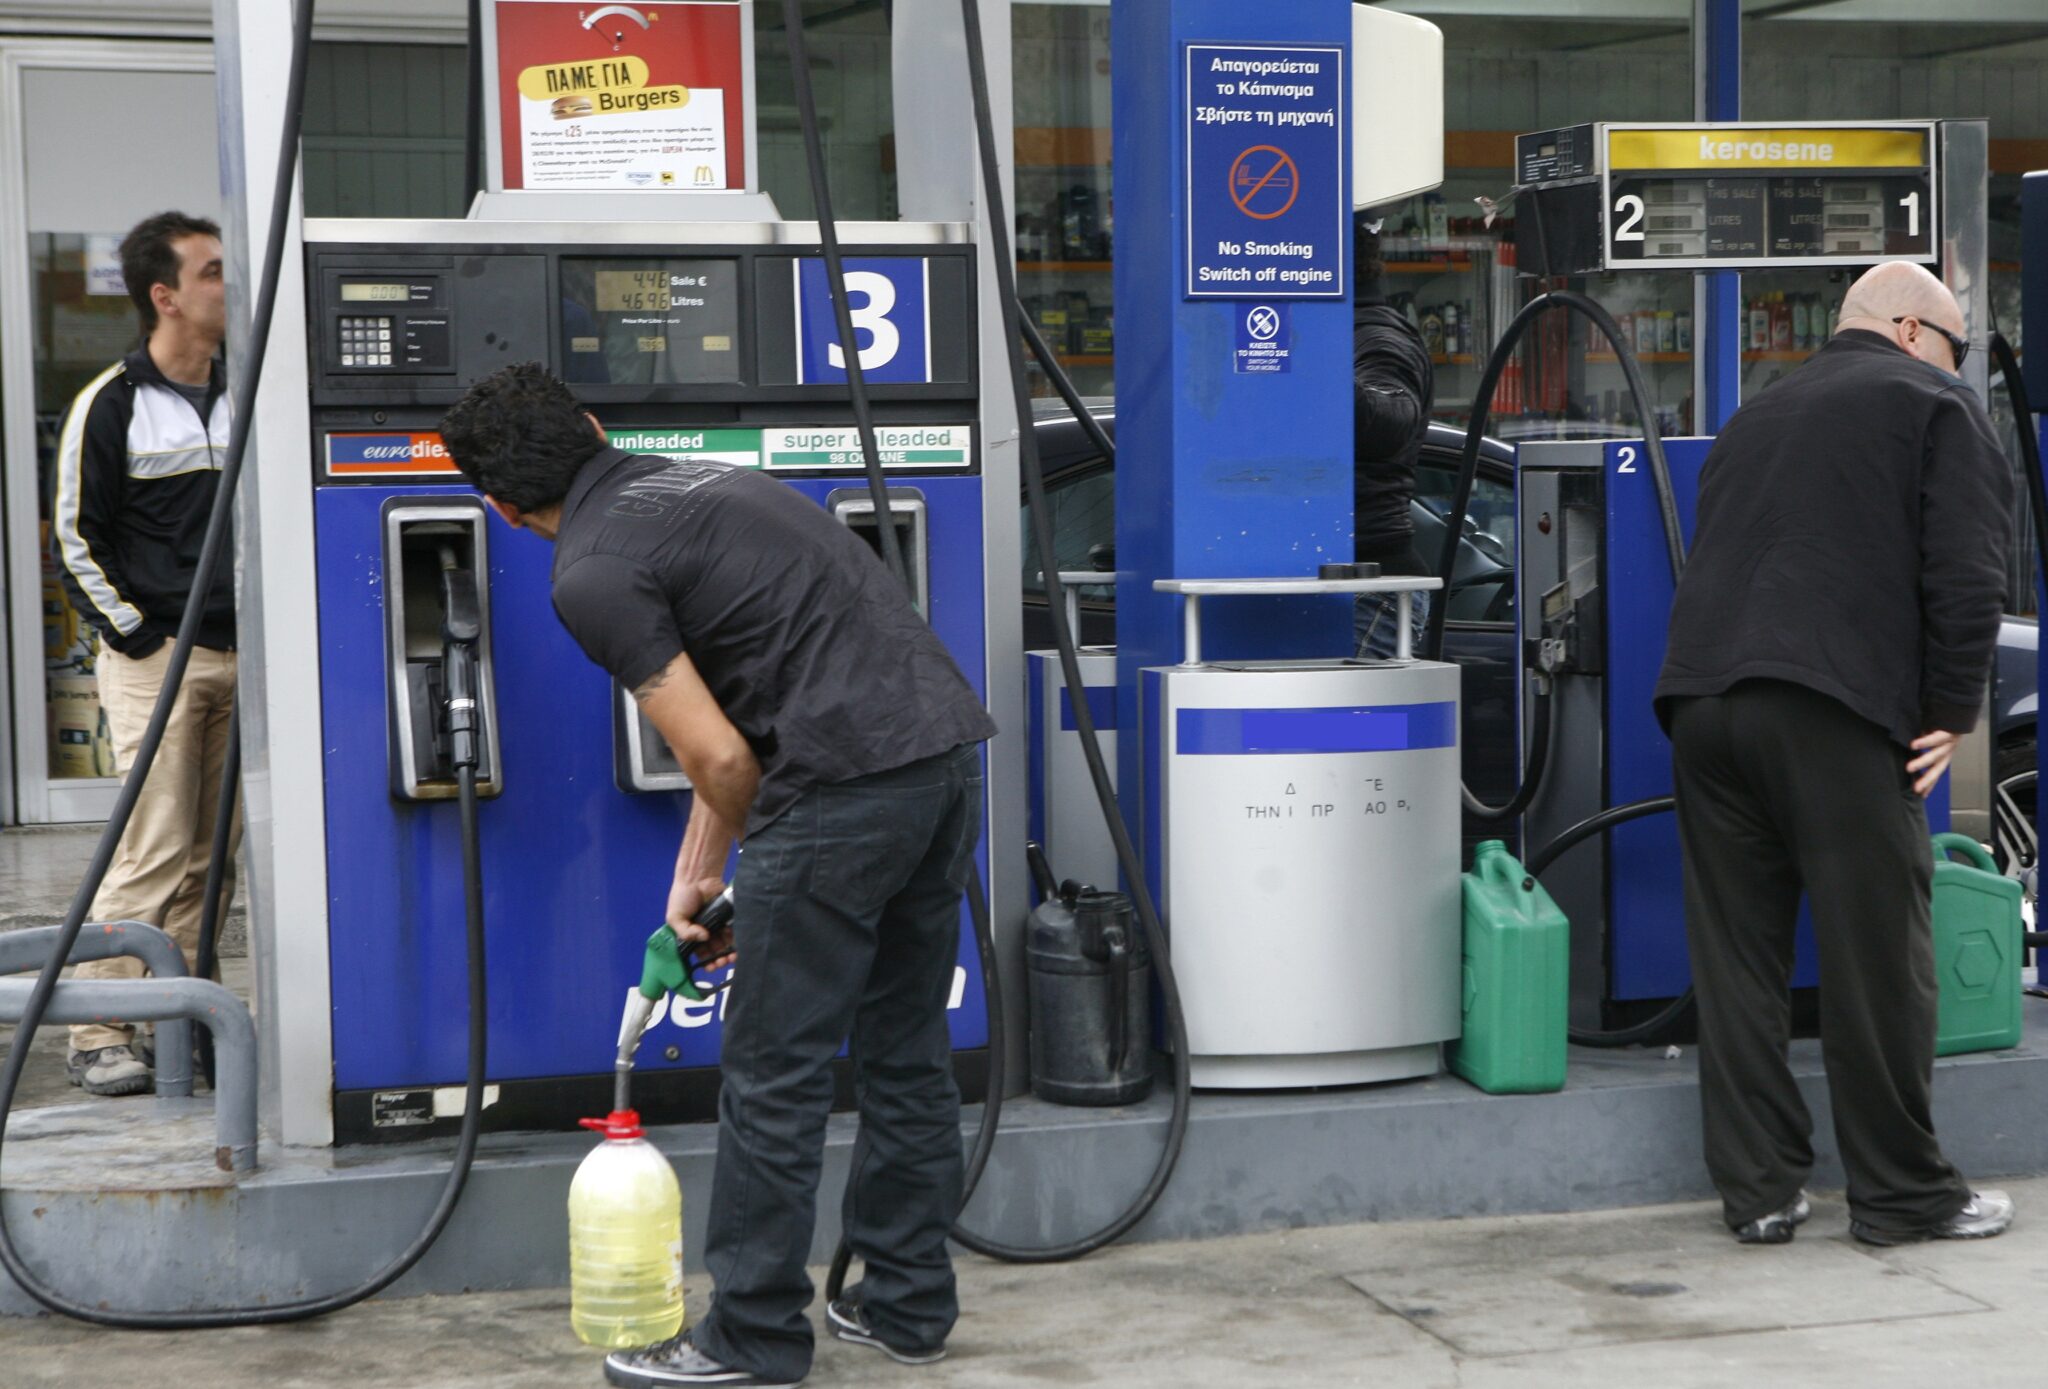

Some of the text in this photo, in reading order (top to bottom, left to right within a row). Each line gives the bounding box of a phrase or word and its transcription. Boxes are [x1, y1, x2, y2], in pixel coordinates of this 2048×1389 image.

[1211, 57, 1320, 76] Απαγορεύεται
[546, 62, 631, 93] ΠΑΜΕ ΓΙΑ
[599, 89, 680, 111] Burgers
[1216, 80, 1315, 100] το Κάπνισμα
[1195, 106, 1334, 127] Σβήστε τη μηχανή
[1699, 135, 1834, 161] kerosene
[1731, 189, 1757, 199] SALE
[1614, 194, 1645, 241] 2
[1708, 215, 1742, 226] LITRES
[1899, 191, 1919, 236] 1
[1218, 241, 1313, 259] No Smoking
[671, 276, 708, 287] Sale €
[1199, 266, 1333, 285] Switch off engine
[671, 296, 705, 306] Litres
[828, 271, 900, 370] 3
[613, 433, 704, 449] unleaded
[784, 430, 951, 451] super uleaded
[829, 451, 907, 464] 98 OANE
[1617, 446, 1636, 473] 2
